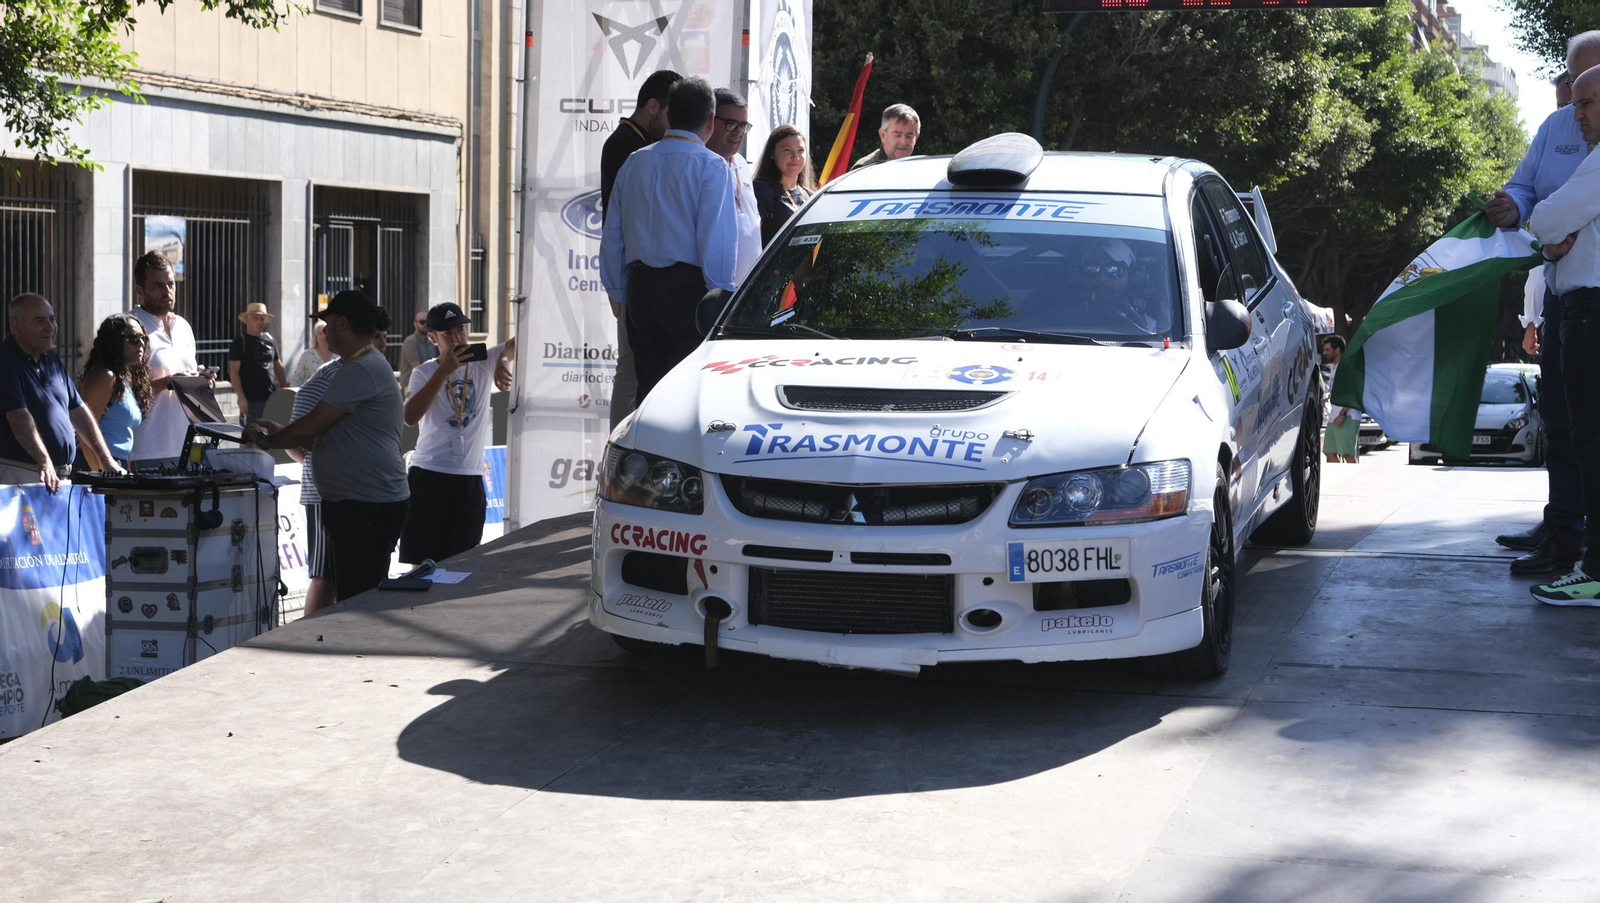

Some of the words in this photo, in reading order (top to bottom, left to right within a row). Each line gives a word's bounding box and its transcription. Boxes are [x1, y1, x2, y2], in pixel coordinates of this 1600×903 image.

[560, 98, 638, 114] CUP
[575, 119, 617, 132] INDAL
[846, 196, 1086, 219] TRASMONTE
[543, 342, 600, 360] Diario
[748, 357, 918, 368] CCRACING
[1028, 371, 1047, 381] 14
[930, 426, 989, 441] grupo
[743, 423, 986, 463] TRASMONTE
[611, 523, 708, 555] CCRACING
[1014, 566, 1021, 575] E
[1027, 548, 1080, 573] 8038
[1084, 546, 1121, 571] FHL
[616, 593, 672, 613] pakelo
[1041, 614, 1114, 632] pakelo
[127, 666, 179, 676] UNLIMITE
[0, 672, 22, 689] EGA
[0, 703, 25, 717] EPORTE
